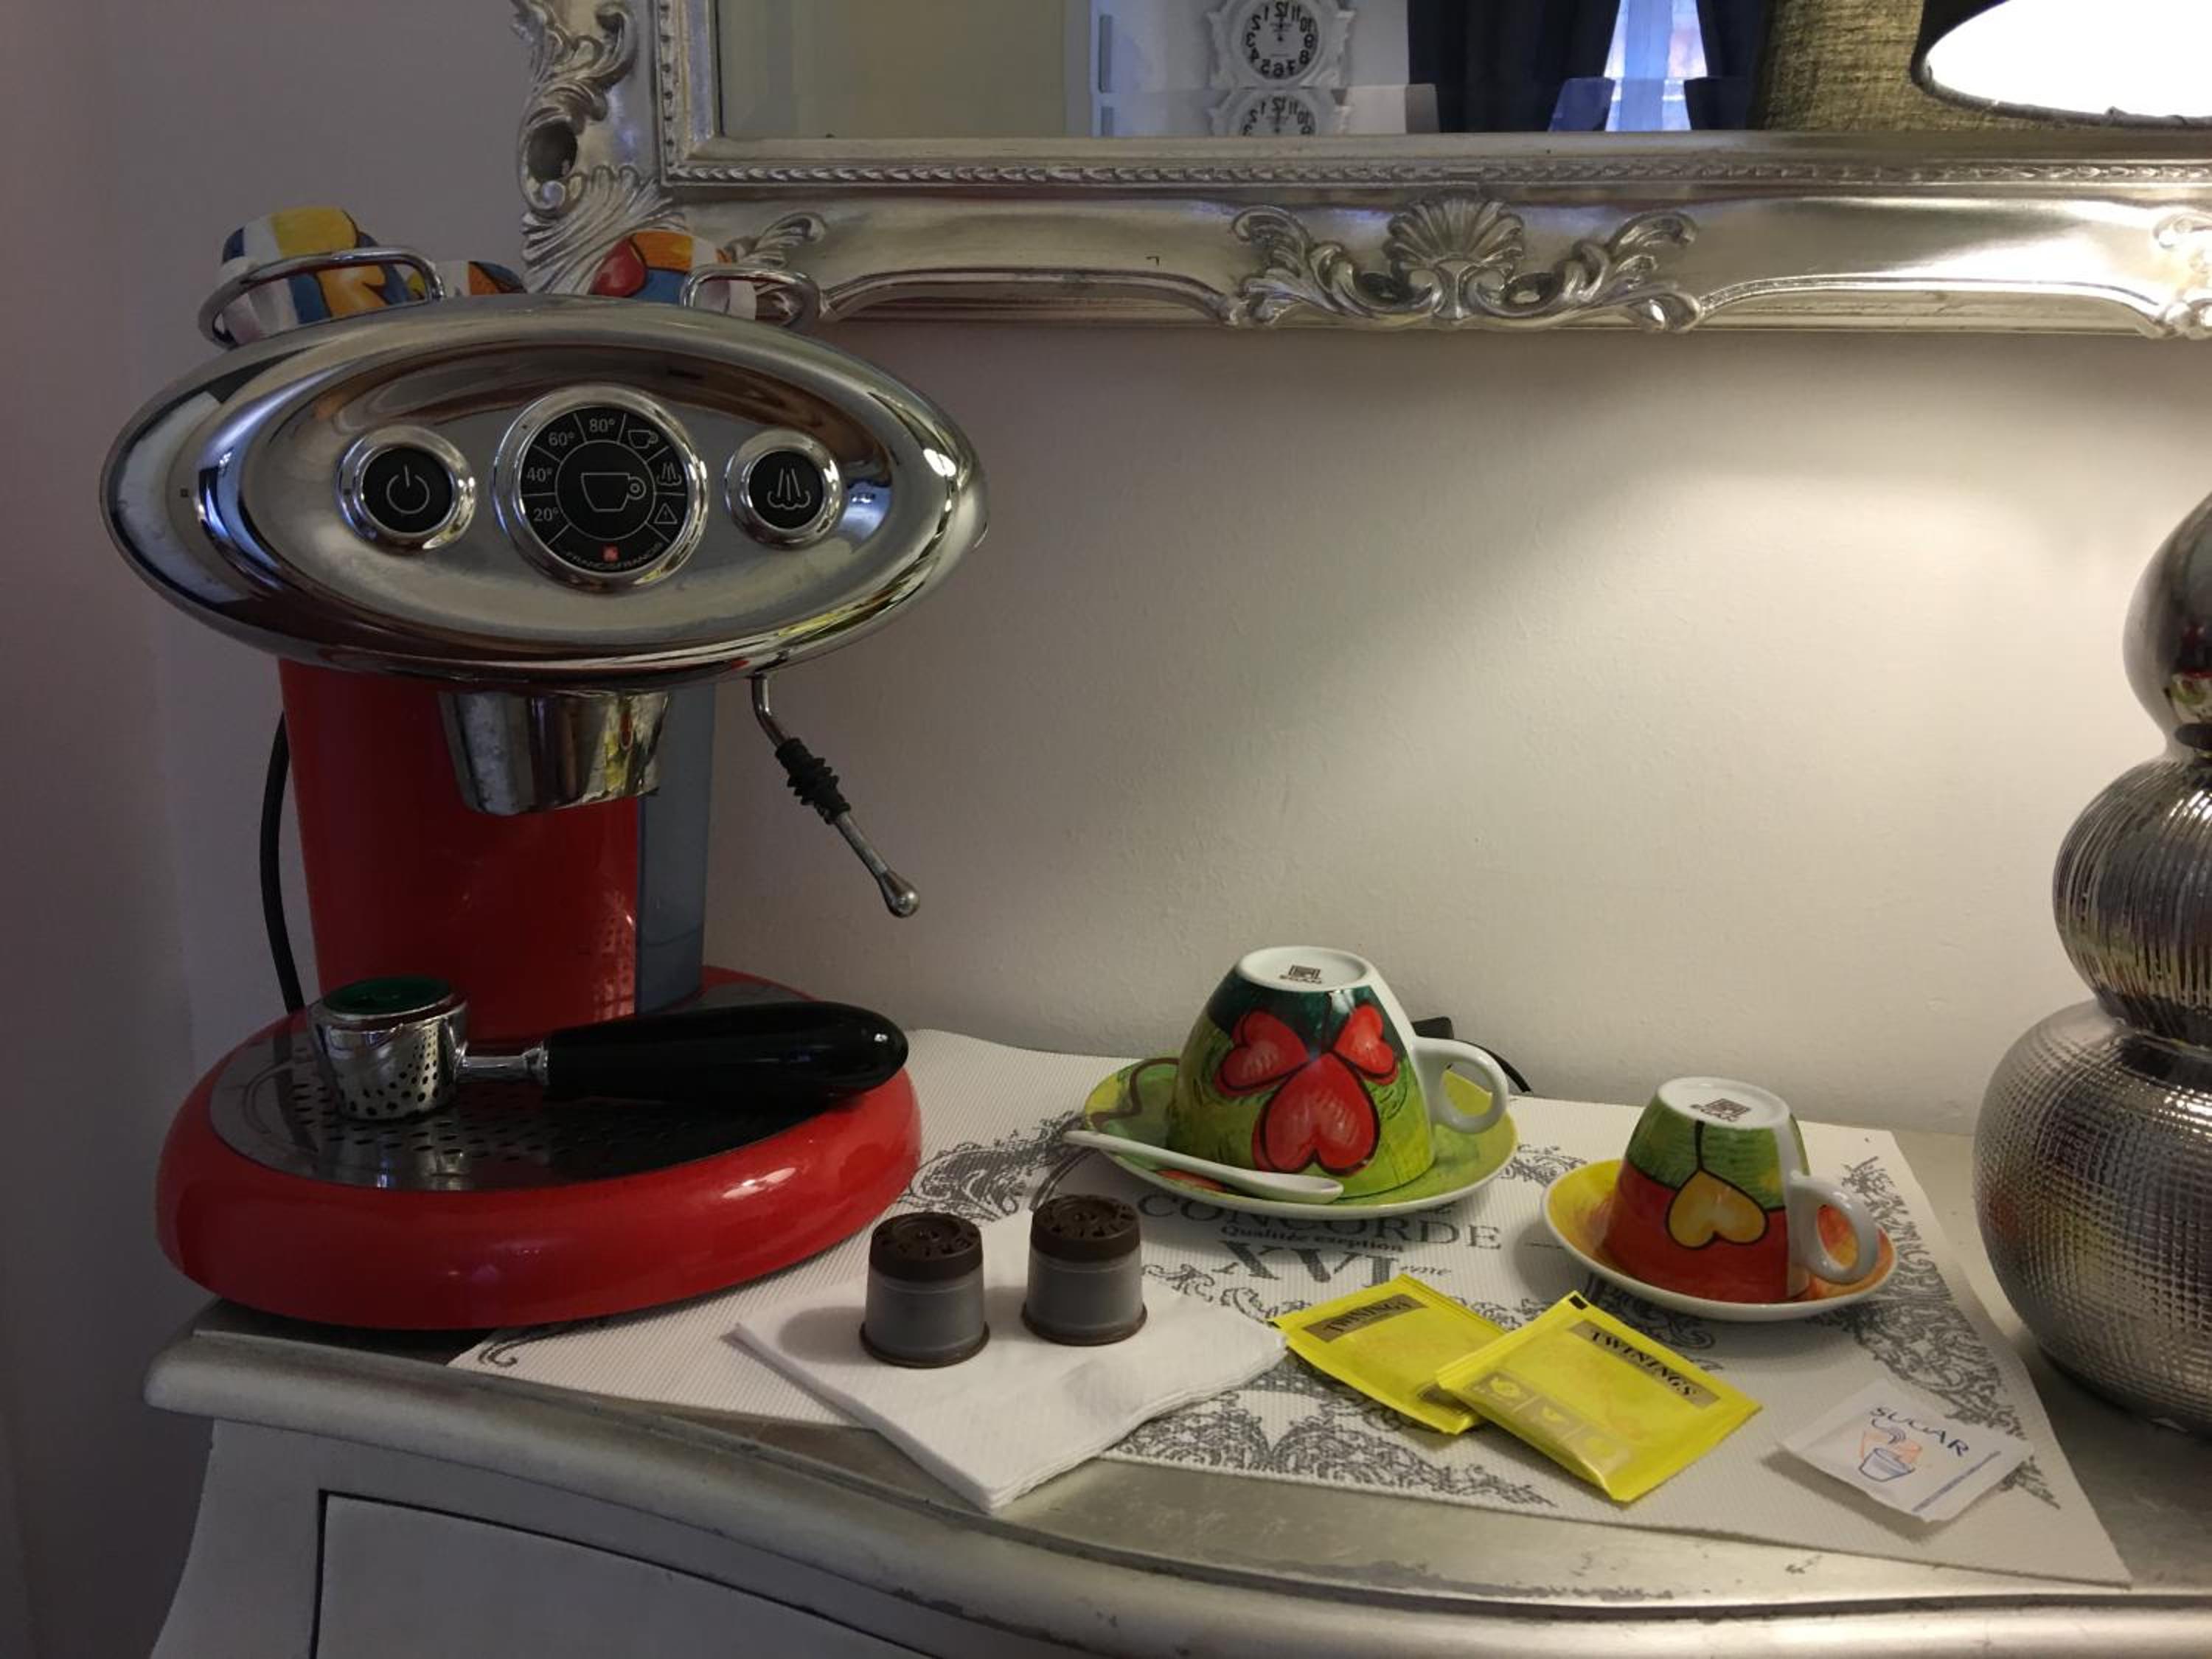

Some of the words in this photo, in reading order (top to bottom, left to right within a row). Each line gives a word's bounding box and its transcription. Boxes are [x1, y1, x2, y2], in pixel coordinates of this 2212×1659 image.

[589, 417, 615, 434] 80°
[548, 431, 575, 446] 60°
[525, 466, 552, 482] 40°
[533, 506, 558, 522] 20°
[1589, 1329, 1697, 1396] TWININGS
[1869, 1408, 1969, 1457] SUGAR
